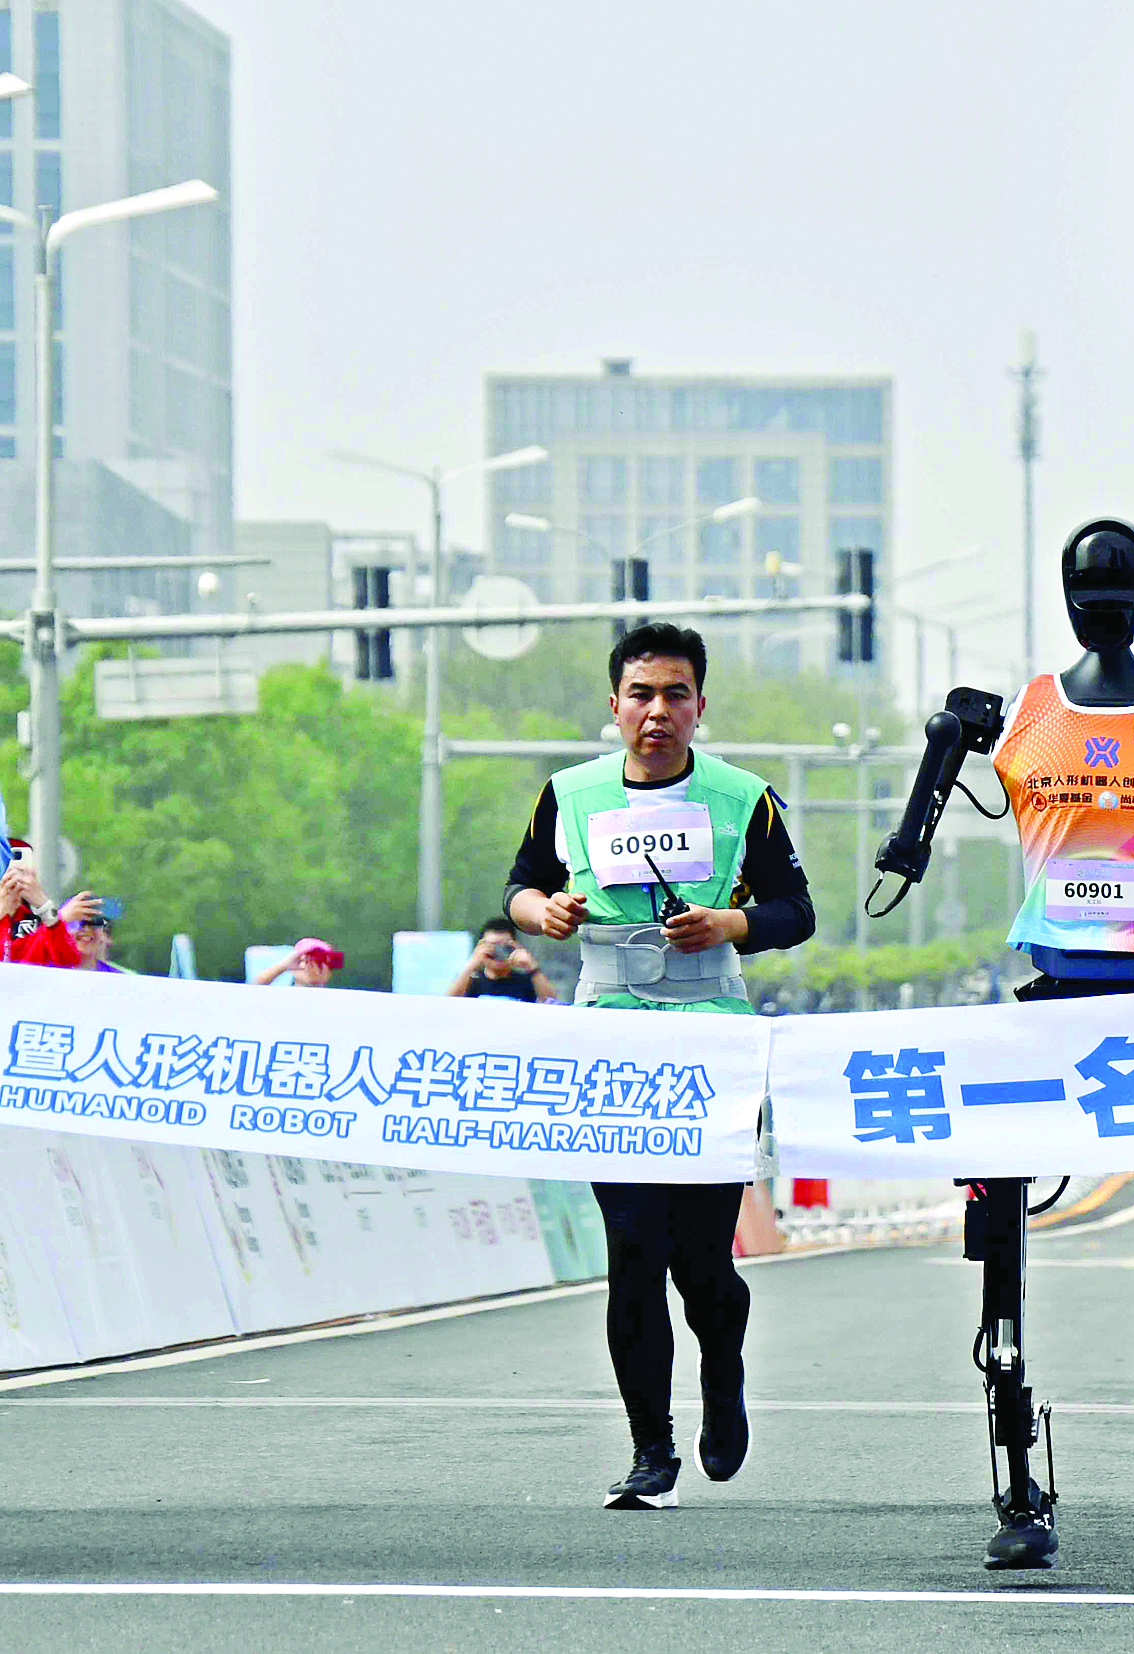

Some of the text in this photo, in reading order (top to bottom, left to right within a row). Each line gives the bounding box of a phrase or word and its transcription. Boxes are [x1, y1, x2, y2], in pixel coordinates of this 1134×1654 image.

[611, 832, 690, 855] 60901
[1064, 882, 1124, 899] 60901
[3, 1020, 715, 1121] 暨人形机器人半程马拉松
[0, 1085, 702, 1156] HUMANOID ROBOT HALF-MARATHON
